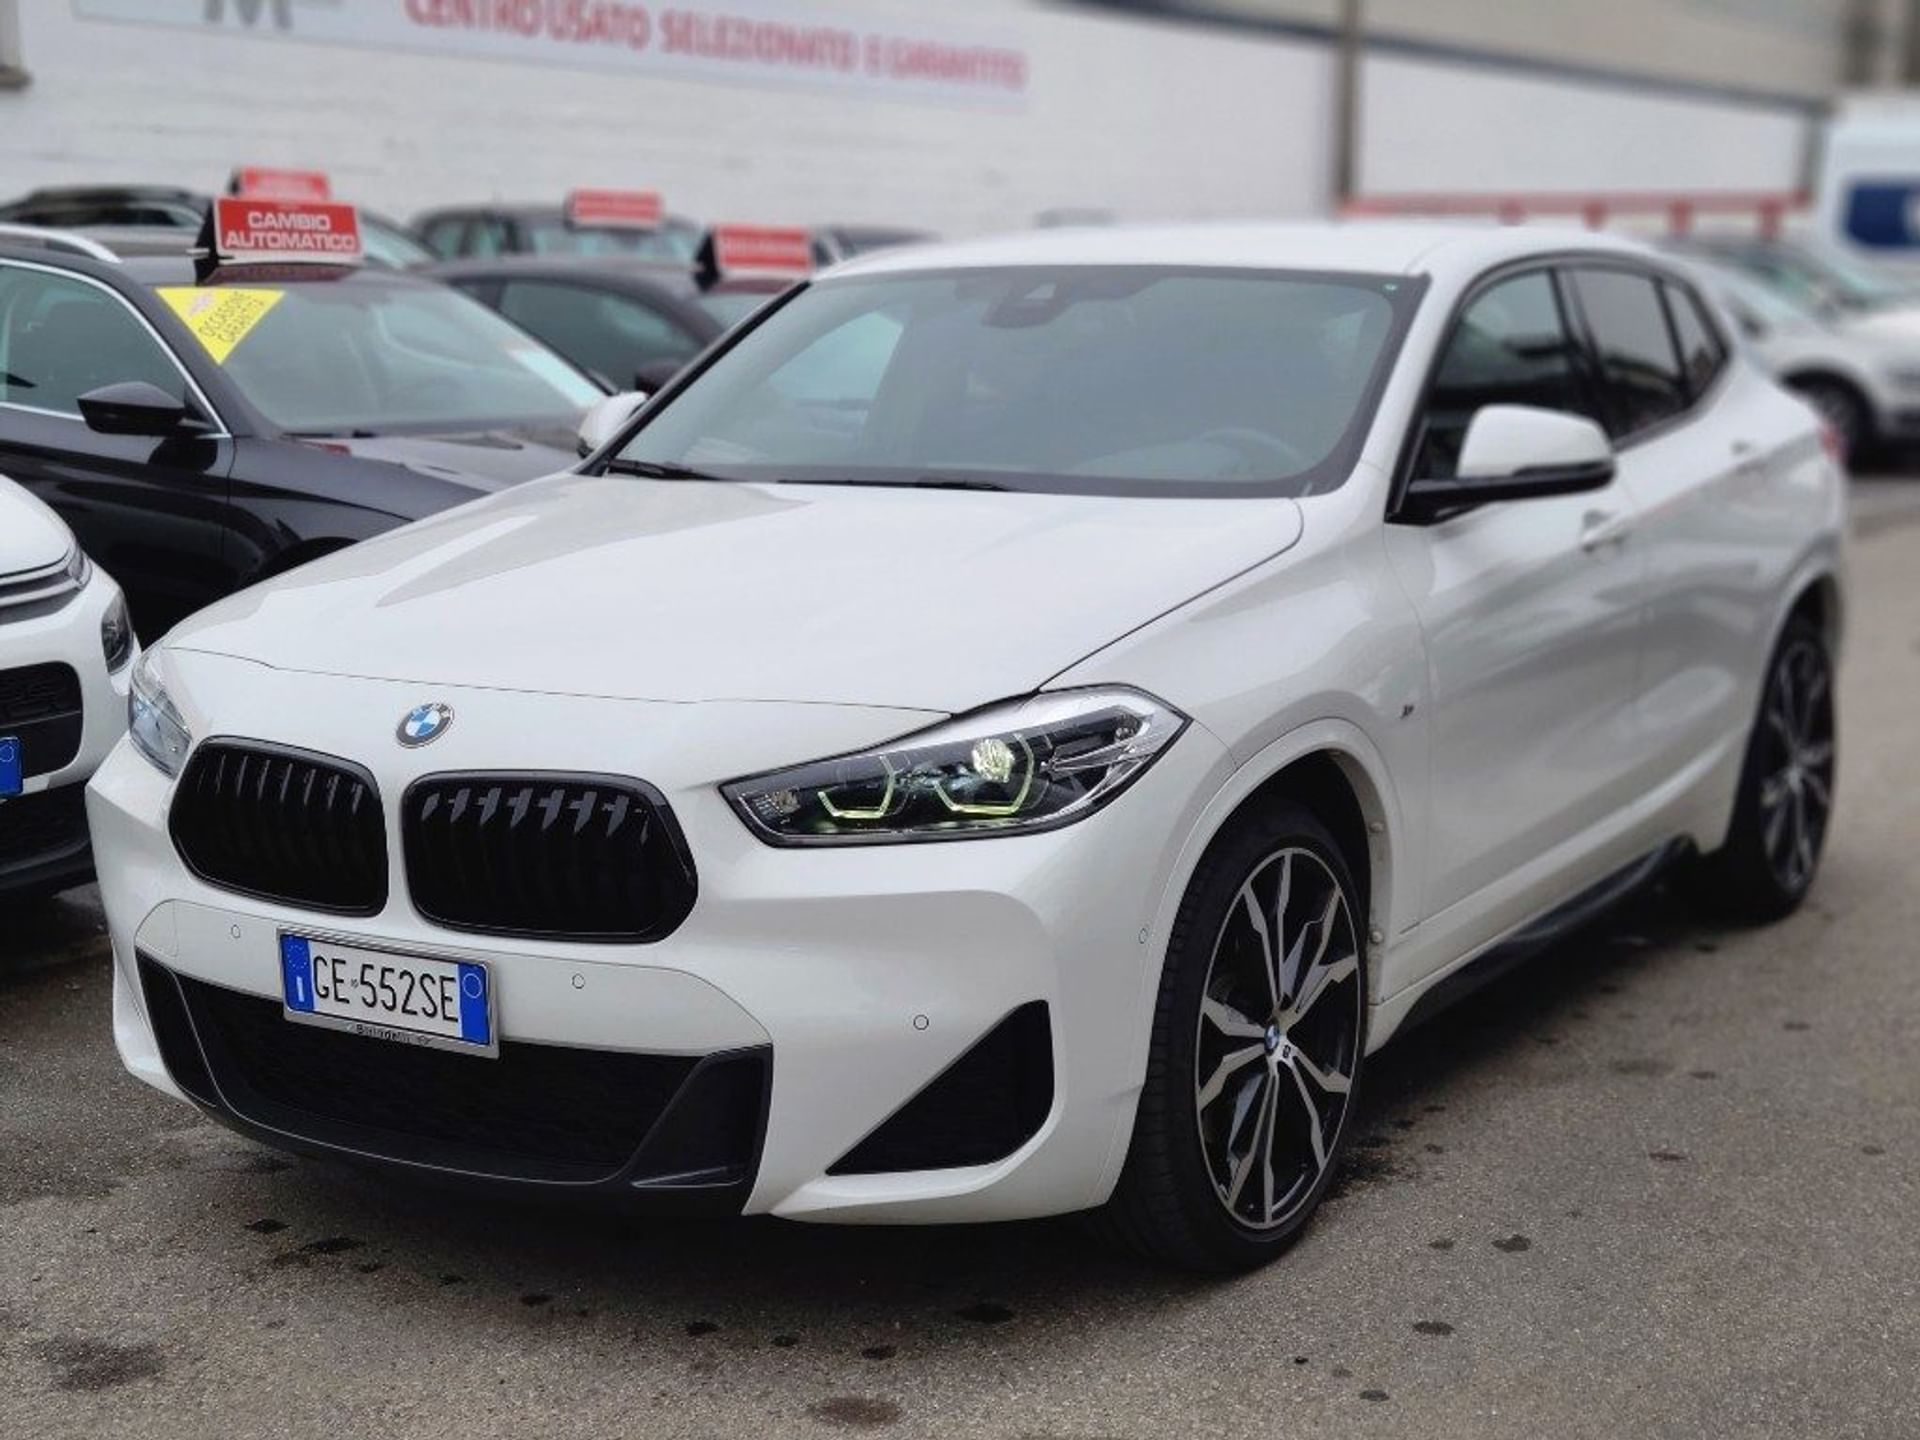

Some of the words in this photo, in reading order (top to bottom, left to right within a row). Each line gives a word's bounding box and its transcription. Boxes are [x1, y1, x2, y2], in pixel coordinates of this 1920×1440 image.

[247, 211, 331, 232] CAMBIO
[225, 230, 356, 251] AUTOMATICO
[312, 954, 350, 1005] GE
[359, 963, 459, 1023] 552SE
